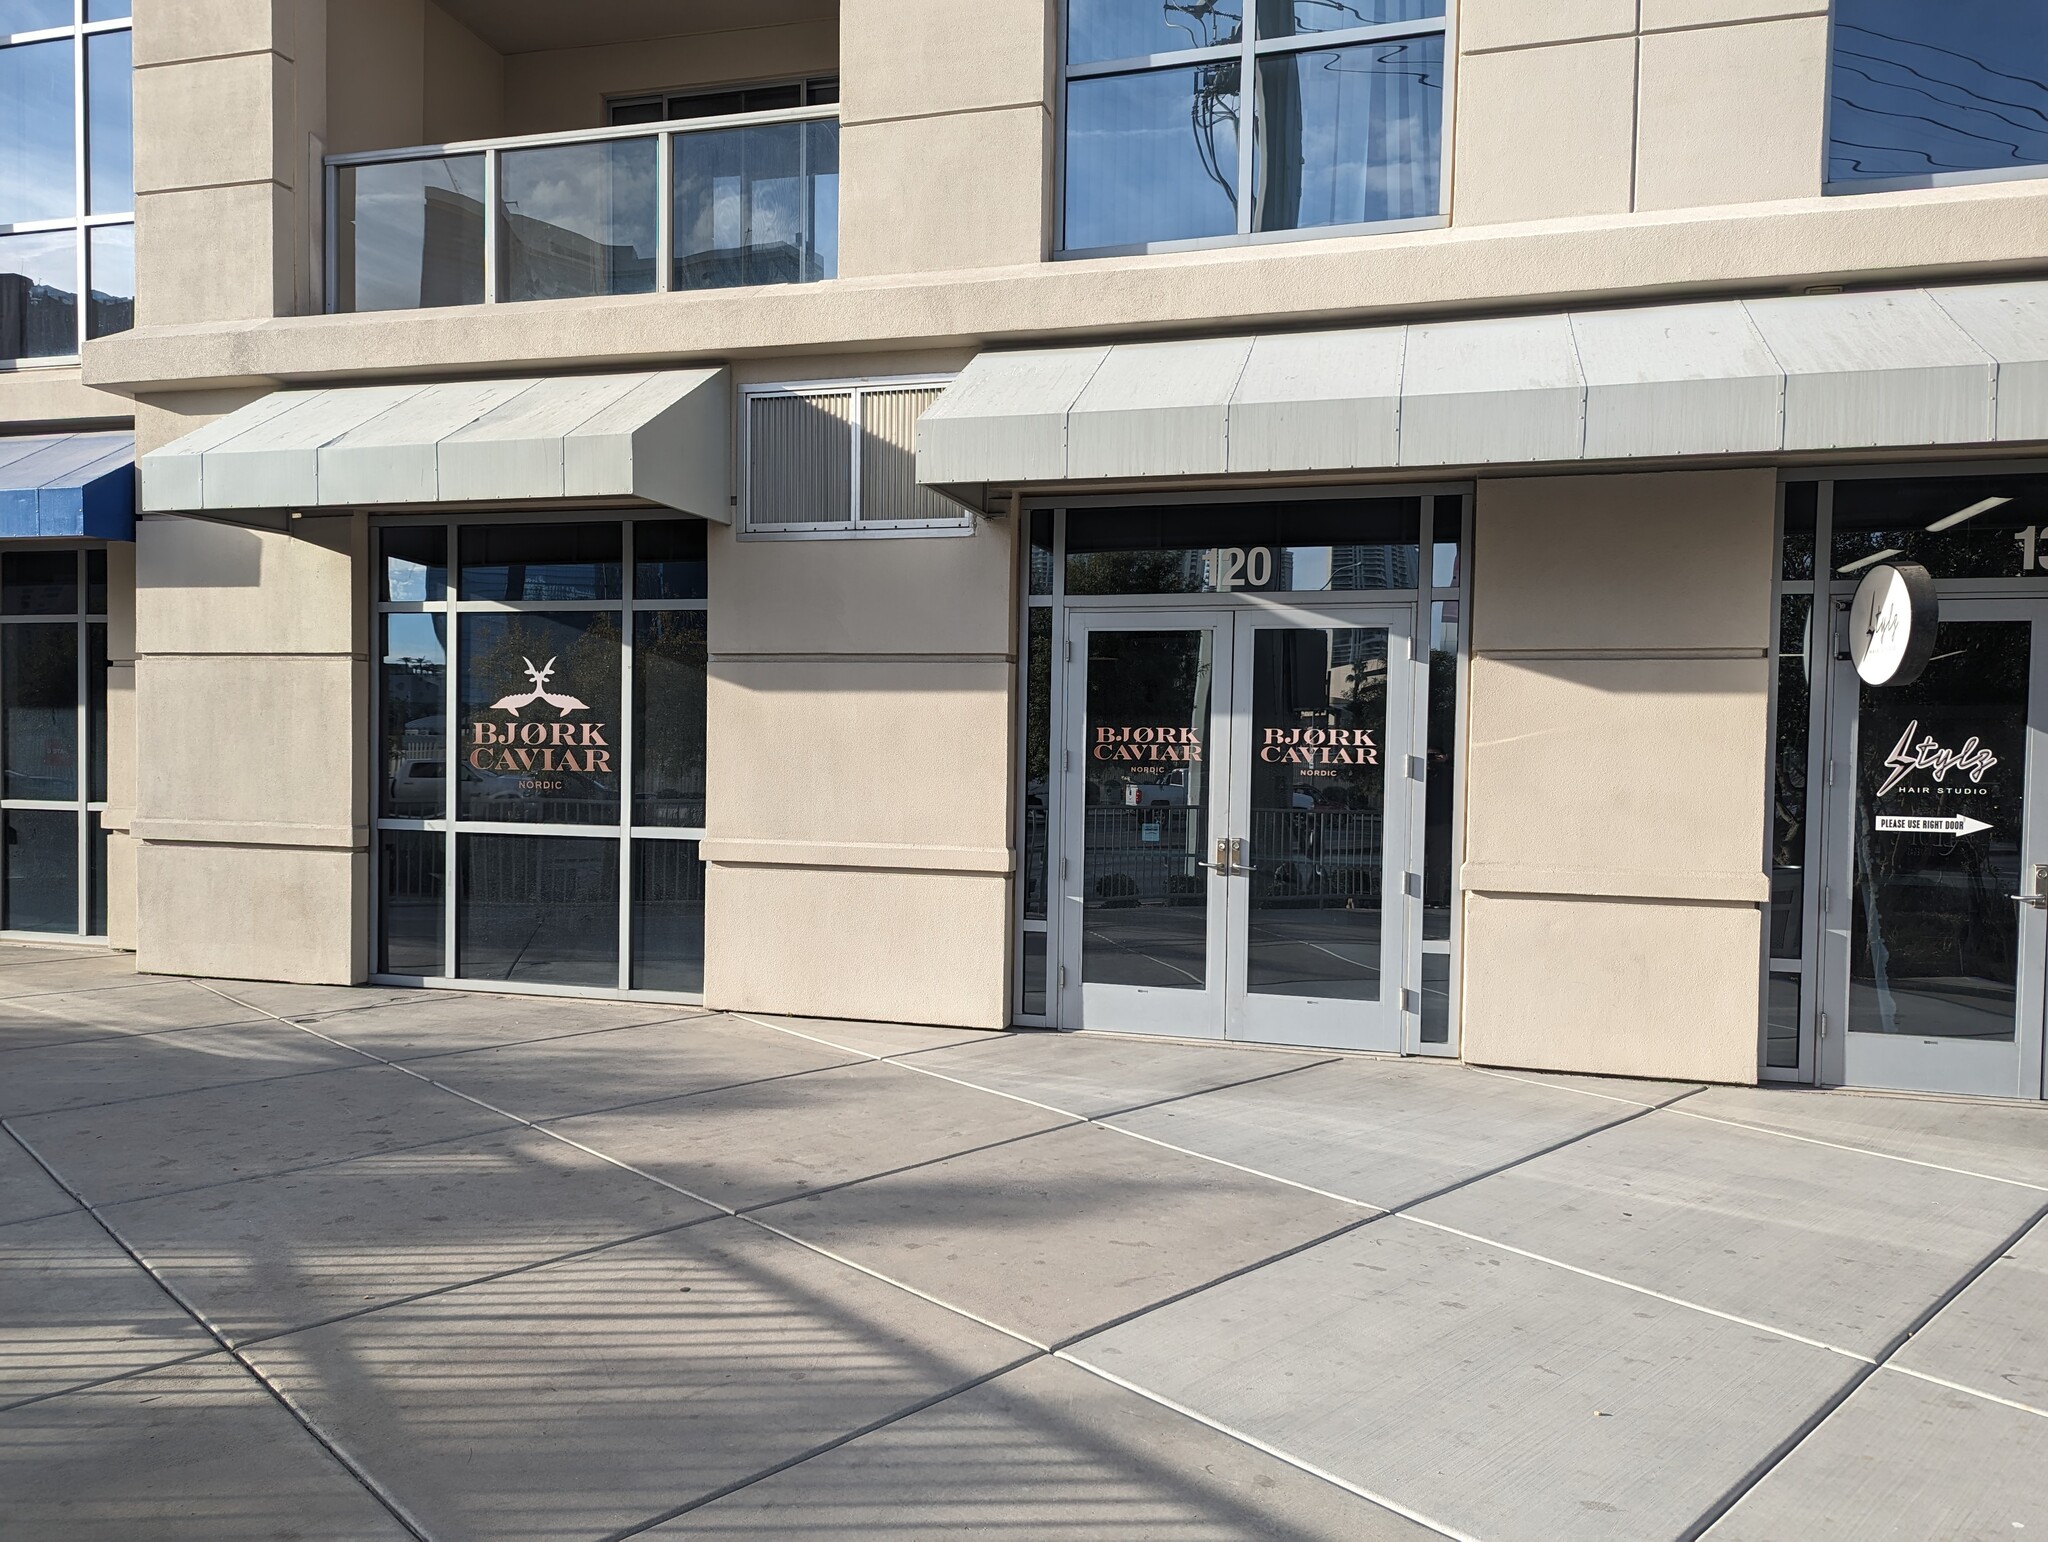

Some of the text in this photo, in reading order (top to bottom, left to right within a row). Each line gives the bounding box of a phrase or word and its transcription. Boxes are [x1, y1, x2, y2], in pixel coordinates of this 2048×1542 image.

[1201, 546, 1272, 587] 120
[472, 721, 610, 746] BJØRK
[1095, 726, 1201, 744] BJØRK
[1263, 728, 1377, 747] BJØRK
[469, 747, 613, 773] CAVIAR
[1093, 744, 1203, 762] CAVIAR
[1260, 746, 1379, 765] CAVIAR
[1876, 719, 1997, 797] Stylz
[1130, 766, 1165, 774] NORDIC
[1299, 769, 1338, 777] NORDIC
[518, 780, 563, 790] NORDIC
[1898, 786, 1988, 795] HAIR STUDIO
[1880, 818, 1965, 830] PLEASE USE RIGHT DOOR
